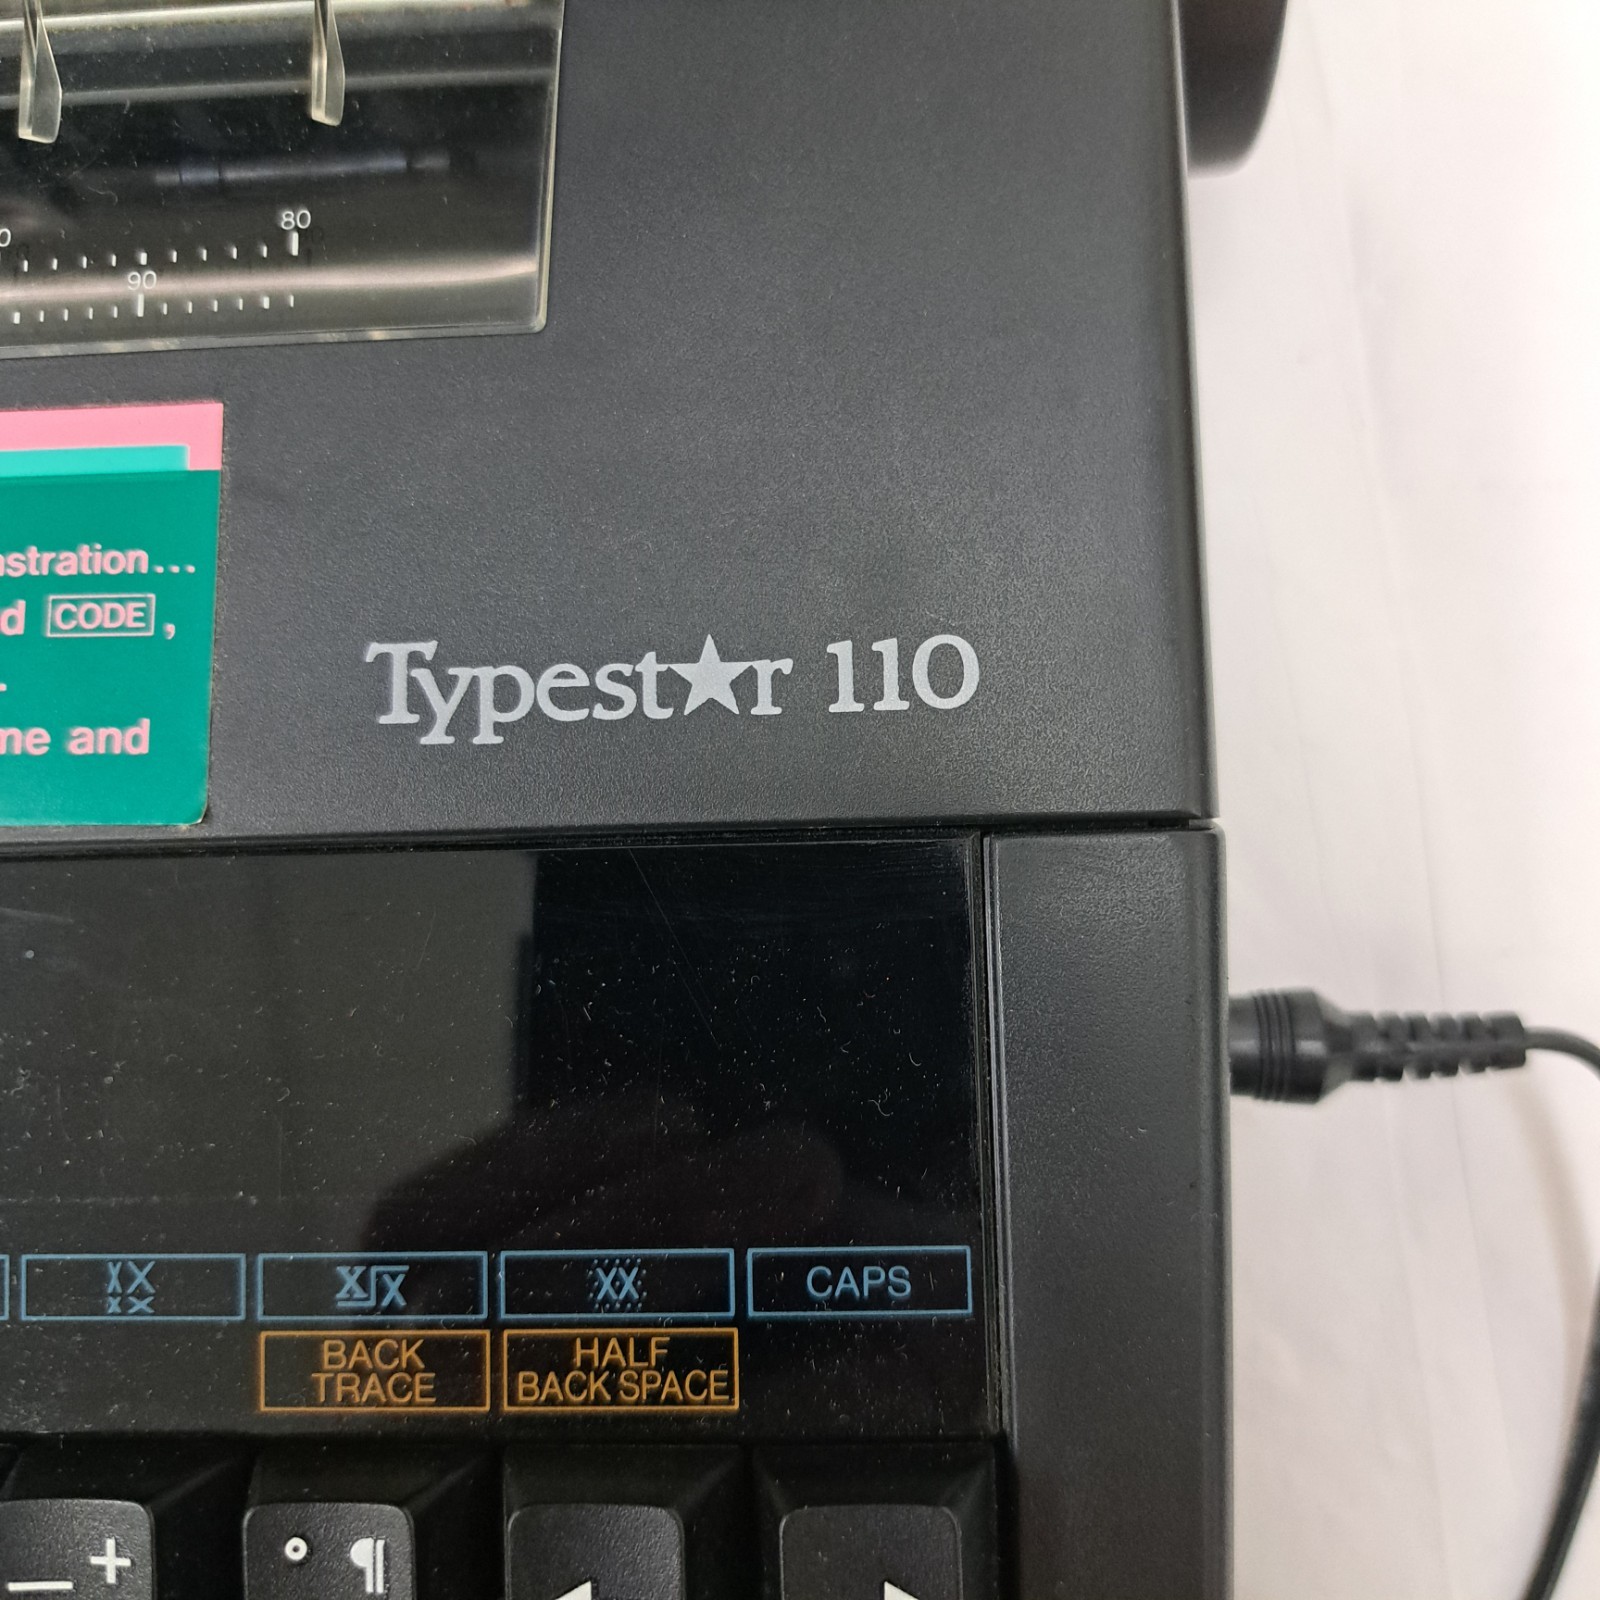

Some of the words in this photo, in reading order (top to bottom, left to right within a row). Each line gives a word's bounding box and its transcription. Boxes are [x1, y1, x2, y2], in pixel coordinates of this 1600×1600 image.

[280, 209, 312, 231] 80
[127, 270, 158, 291] 90
[0, 543, 196, 577] stration...
[54, 602, 148, 630] CODE
[826, 634, 981, 713] 110
[66, 717, 151, 756] and
[806, 1265, 912, 1300] CAPS
[322, 1339, 425, 1371] BACK
[573, 1336, 671, 1368] HALF
[311, 1373, 436, 1403] TRACE
[517, 1370, 611, 1401] BACK
[616, 1369, 730, 1400] SPACE
